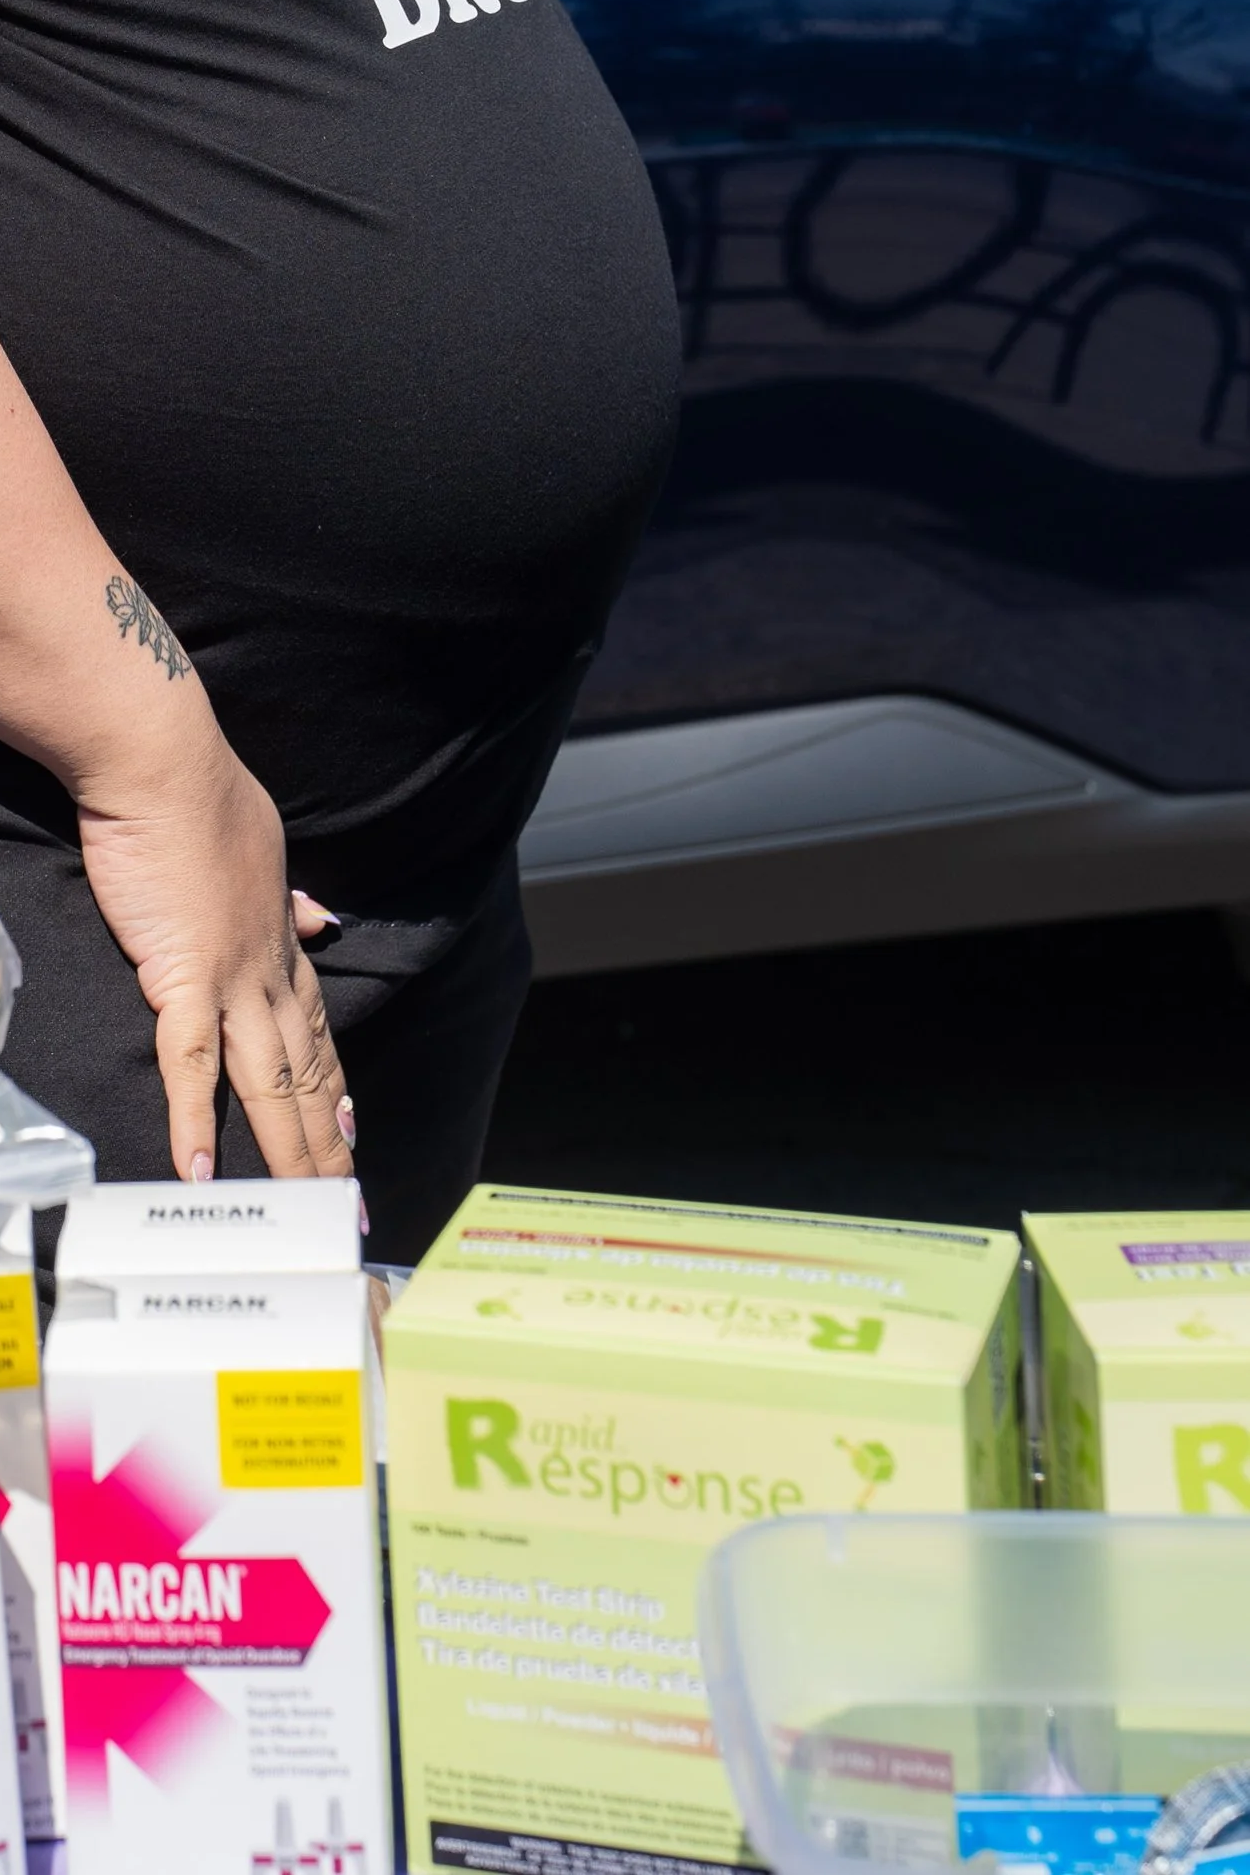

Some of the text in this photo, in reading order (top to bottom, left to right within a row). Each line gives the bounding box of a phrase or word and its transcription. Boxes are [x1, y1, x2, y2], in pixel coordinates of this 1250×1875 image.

[148, 1205, 266, 1222] NARCAN
[143, 1295, 268, 1313] NARCAN
[57, 1561, 243, 1623] NARCAN
[417, 1568, 666, 1622] Xylazine Test Strip
[572, 1623, 605, 1649] de
[420, 1638, 472, 1670] Tira
[477, 1649, 510, 1673] de
[515, 1655, 613, 1688] prueba
[617, 1667, 652, 1692] de
